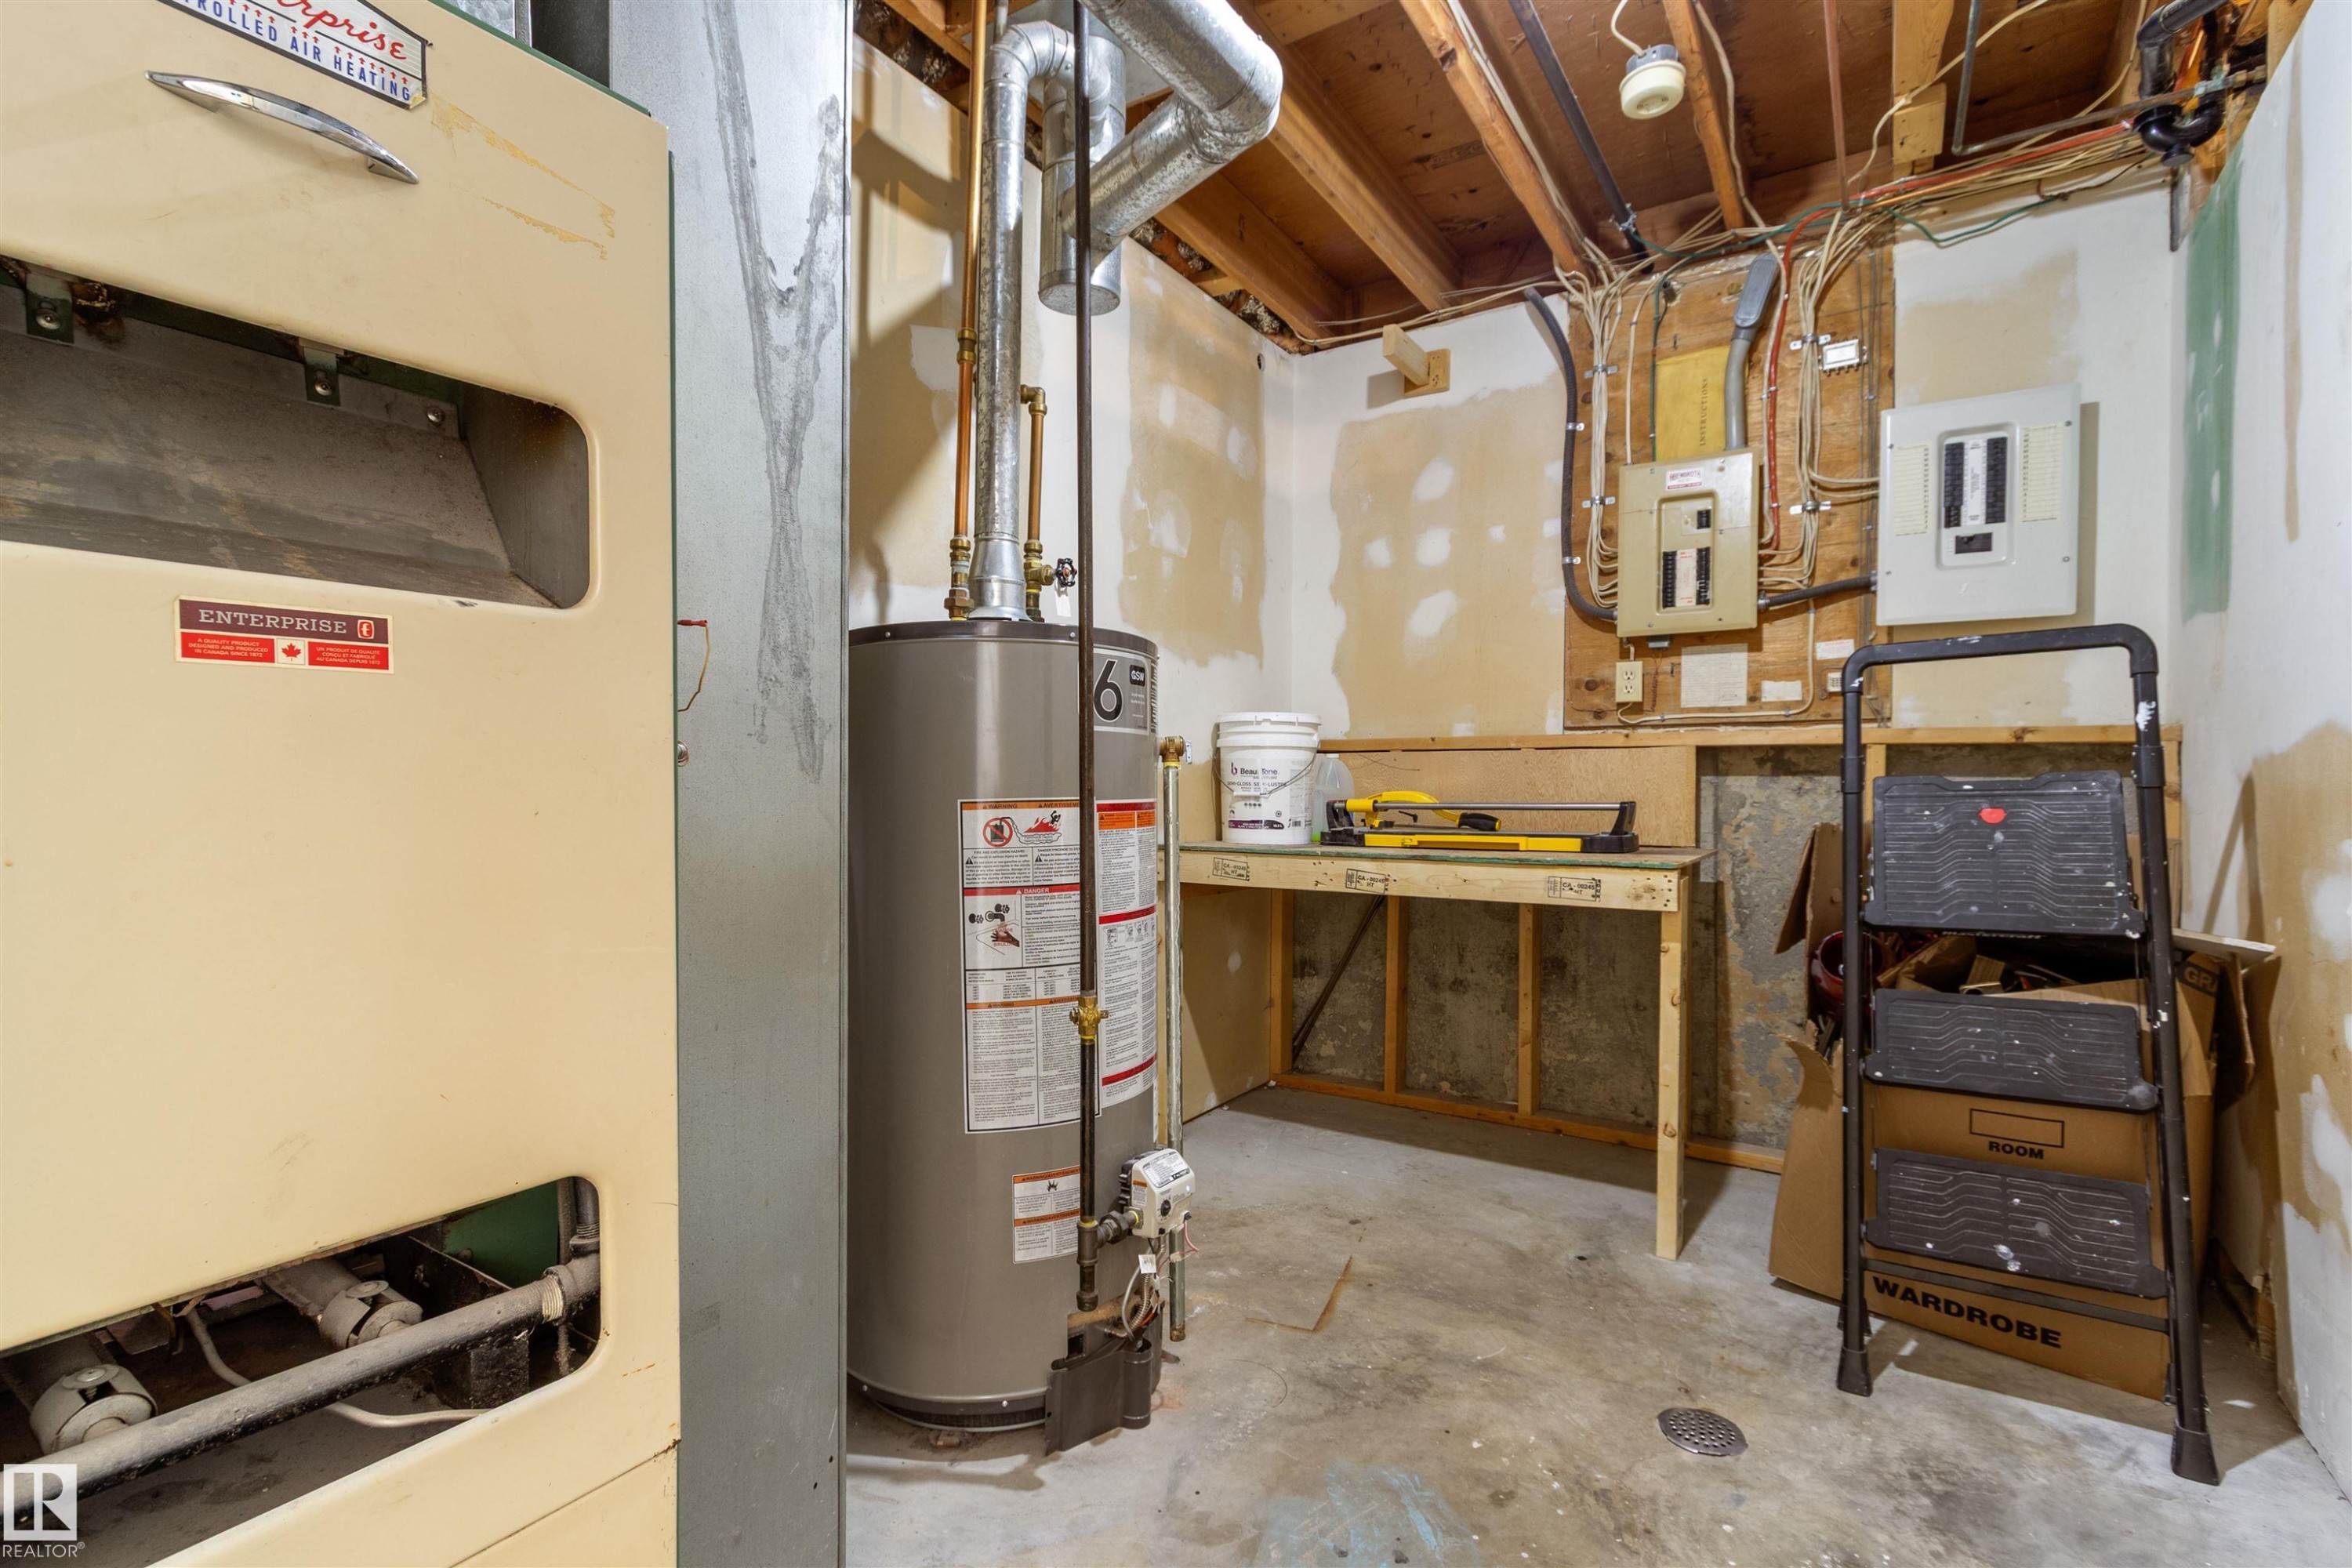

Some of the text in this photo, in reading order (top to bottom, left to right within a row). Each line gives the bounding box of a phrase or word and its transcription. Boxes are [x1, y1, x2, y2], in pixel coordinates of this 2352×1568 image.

[290, 36, 321, 63] AIR
[334, 55, 410, 102] HEATING
[198, 608, 347, 633] ENTERPRISE
[1094, 659, 1123, 722] 6
[1131, 670, 1145, 682] GSW
[1988, 1140, 2044, 1160] ROOM
[1872, 1276, 2061, 1348] WARDROBE
